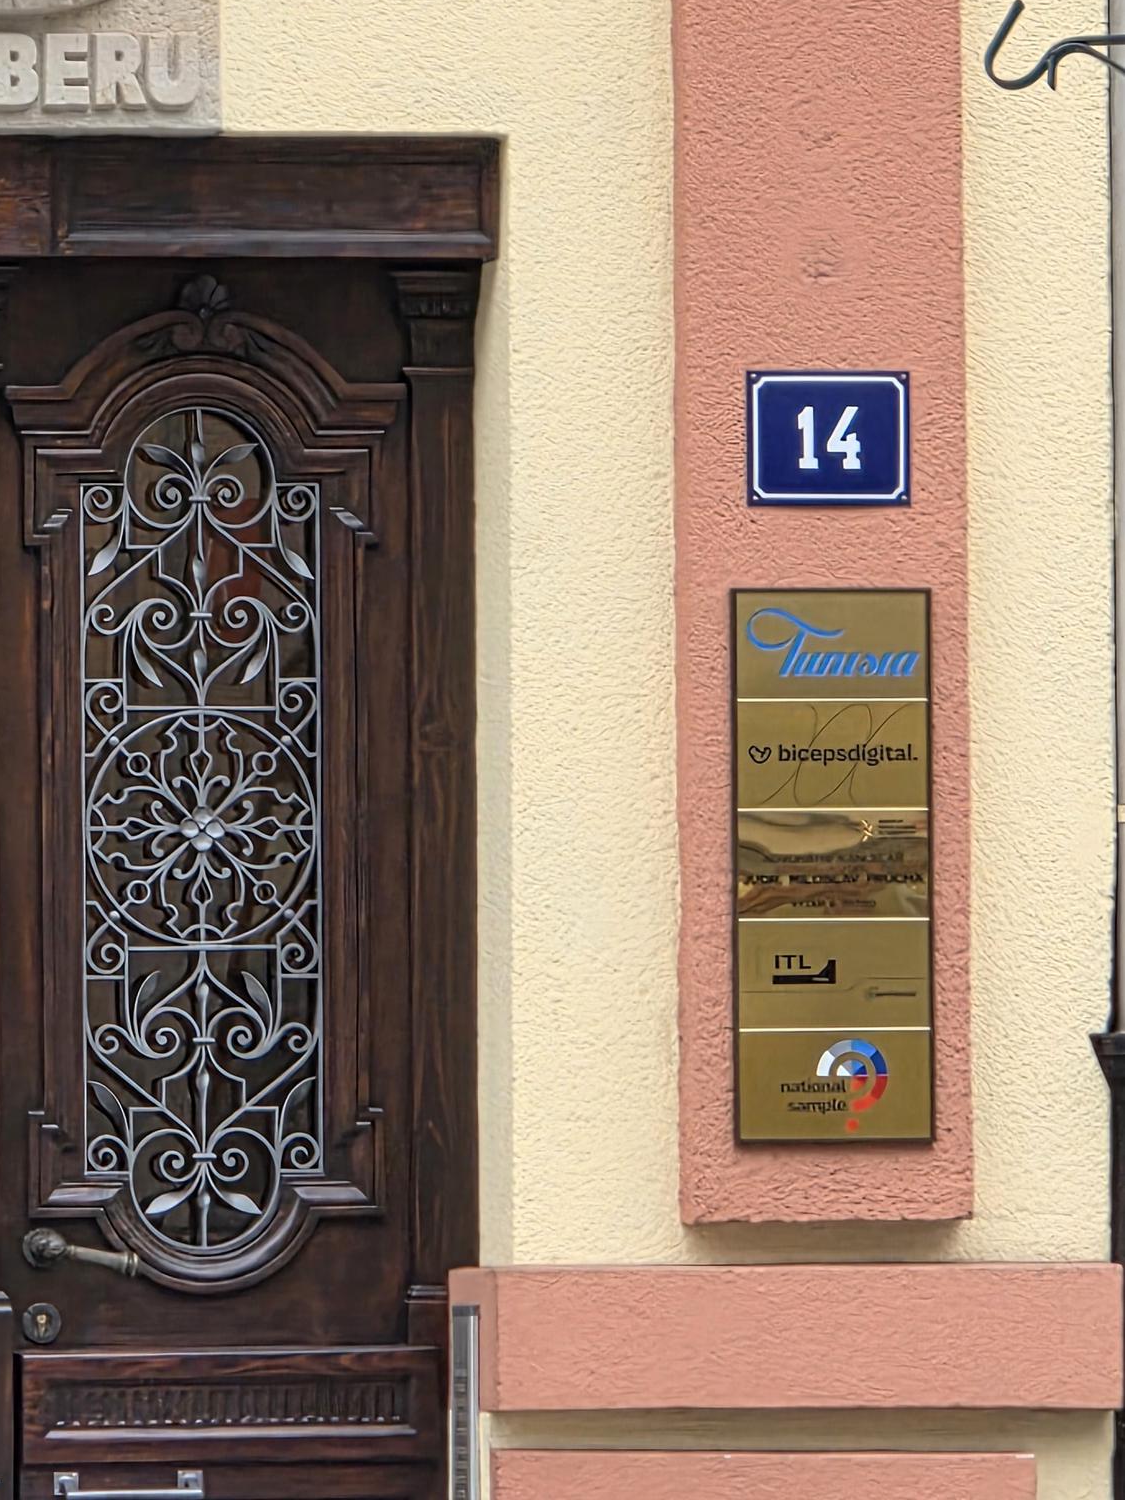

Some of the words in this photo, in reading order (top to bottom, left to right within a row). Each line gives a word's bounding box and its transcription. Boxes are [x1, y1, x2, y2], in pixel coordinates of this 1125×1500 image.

[797, 406, 862, 470] 14
[774, 954, 812, 970] ITL
[780, 1077, 847, 1093] national
[787, 1099, 847, 1113] sample
